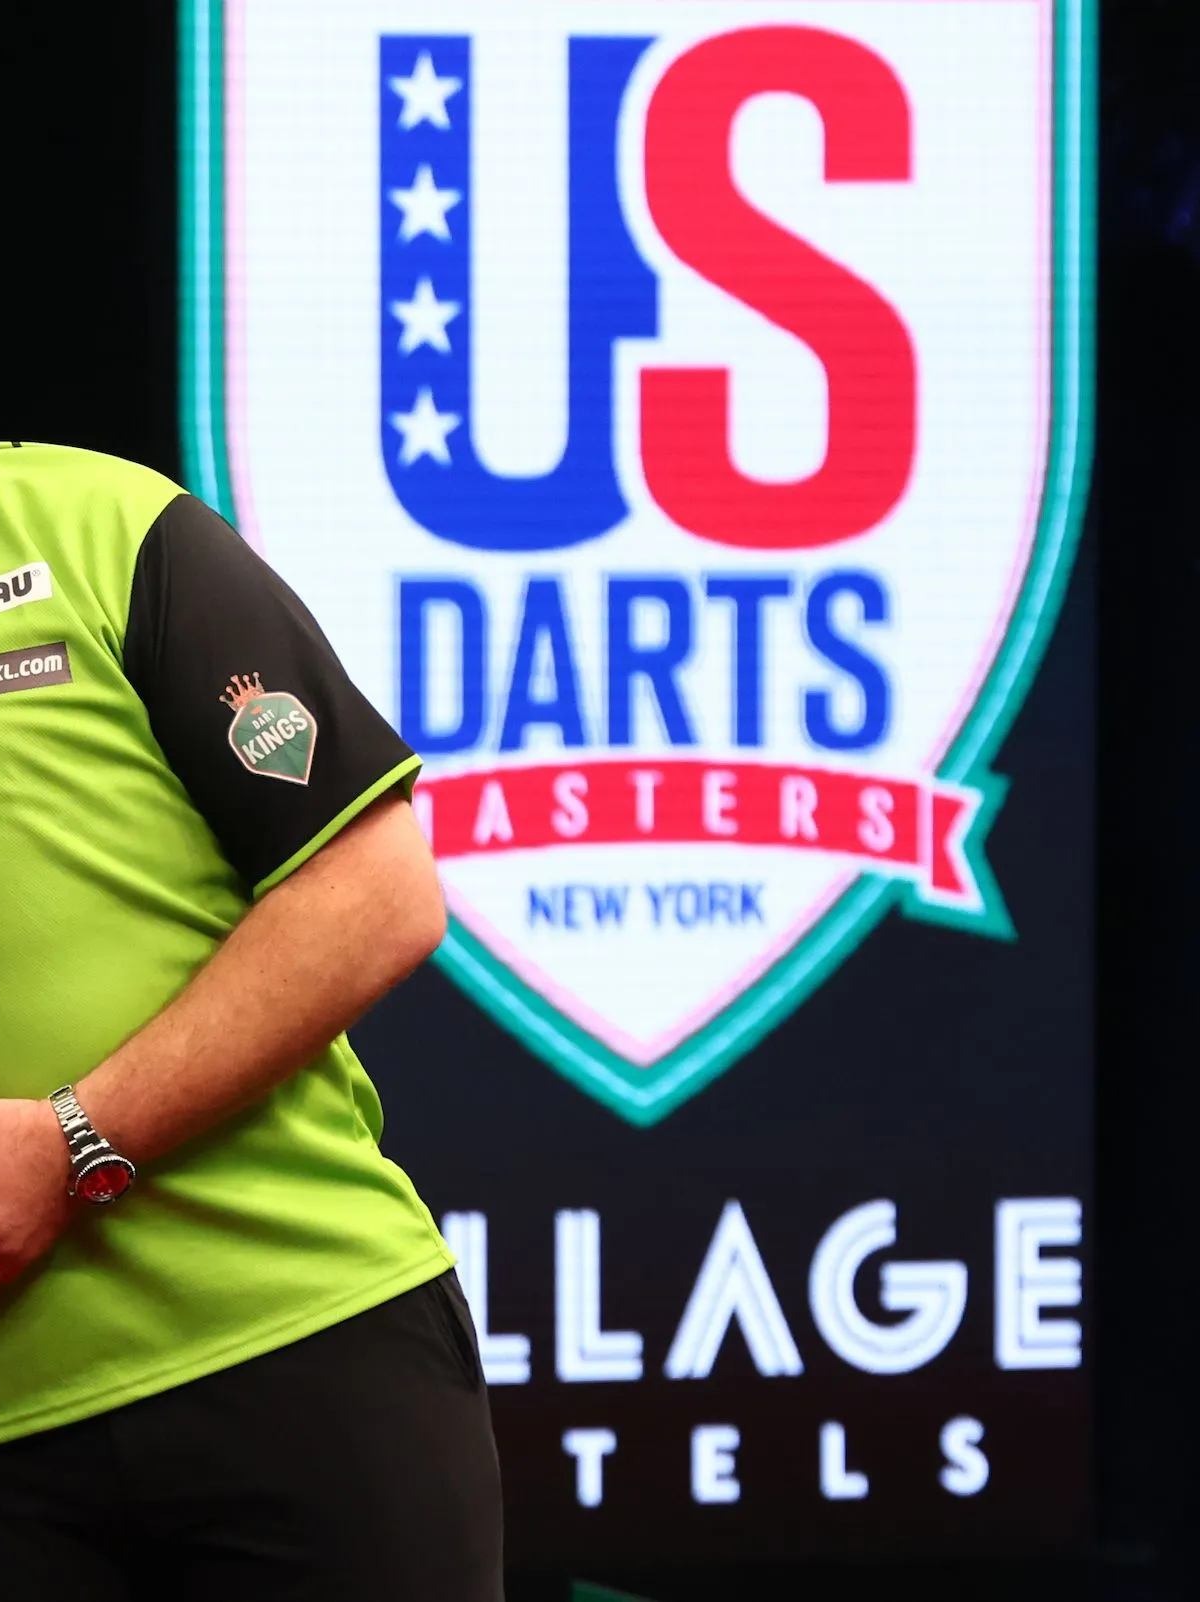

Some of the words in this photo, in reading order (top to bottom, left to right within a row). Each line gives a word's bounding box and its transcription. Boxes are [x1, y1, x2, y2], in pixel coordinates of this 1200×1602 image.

[379, 24, 918, 552] US
[396, 571, 891, 754] DARTS
[241, 710, 308, 765] KINGS
[251, 709, 276, 730] DART
[413, 770, 896, 852] ASTERS
[527, 882, 631, 927] NEW
[647, 881, 763, 925] YORK
[441, 1197, 1083, 1385] LLAGE
[561, 1415, 990, 1508] TELS
